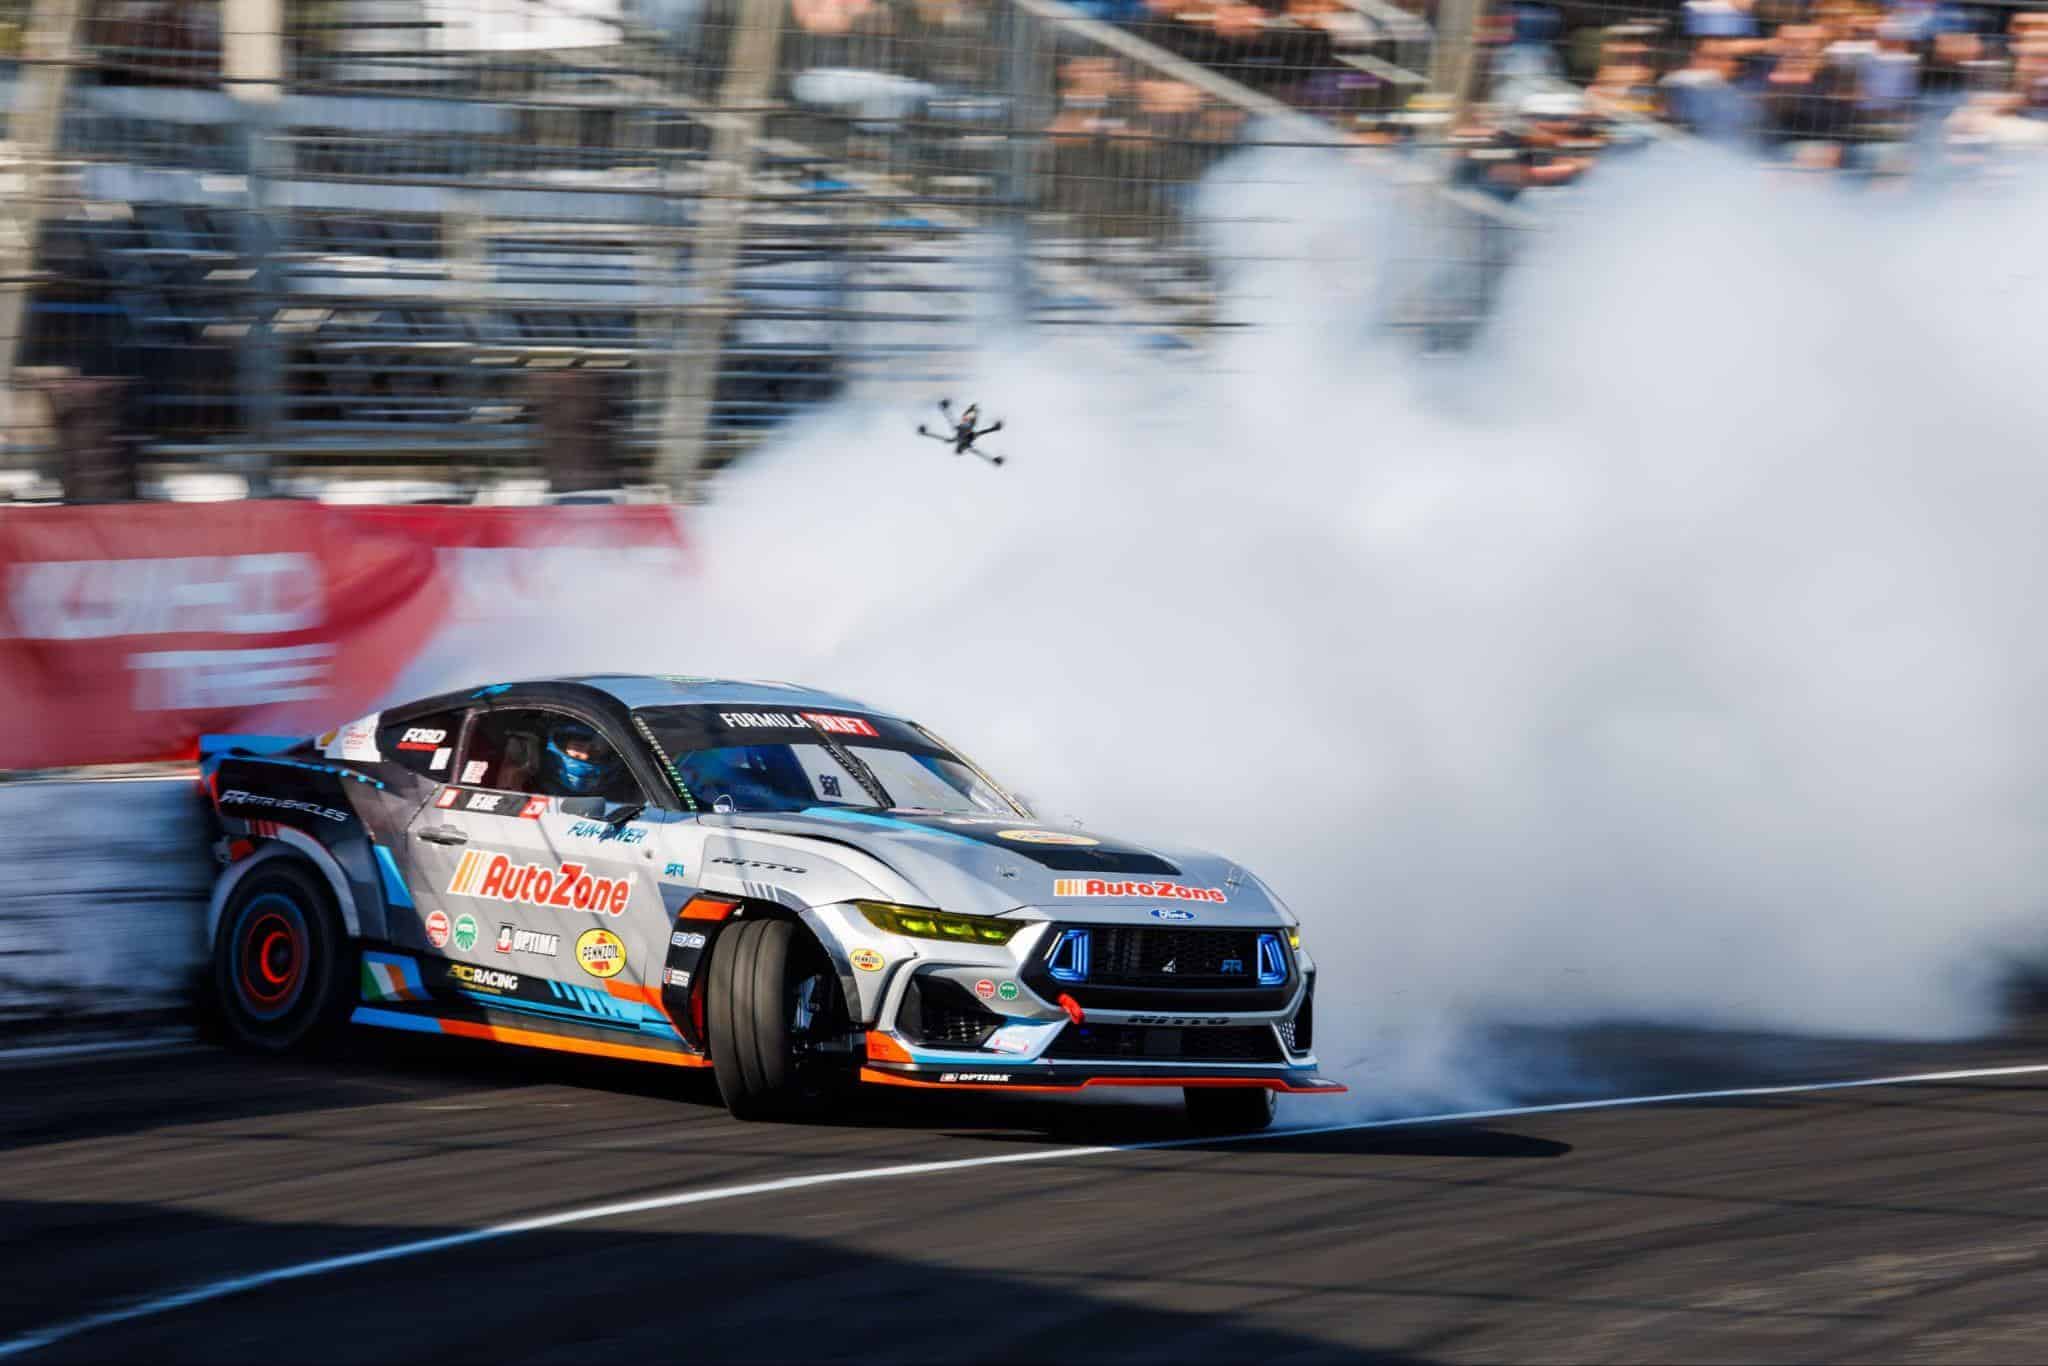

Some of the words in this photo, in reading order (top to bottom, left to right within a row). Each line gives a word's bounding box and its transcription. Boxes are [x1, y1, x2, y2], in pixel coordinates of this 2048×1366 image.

[719, 712, 812, 729] FORMULA
[401, 728, 447, 744] FORD
[275, 799, 349, 822] VEHICLES
[711, 857, 807, 874] NITTO
[480, 854, 630, 916] AutoZone
[1086, 880, 1226, 903] AutoZone
[512, 929, 559, 956] OPTIMA
[583, 944, 618, 960] PENNZOIL
[473, 969, 519, 990] RACING
[959, 1073, 1010, 1082] OPTIMA
